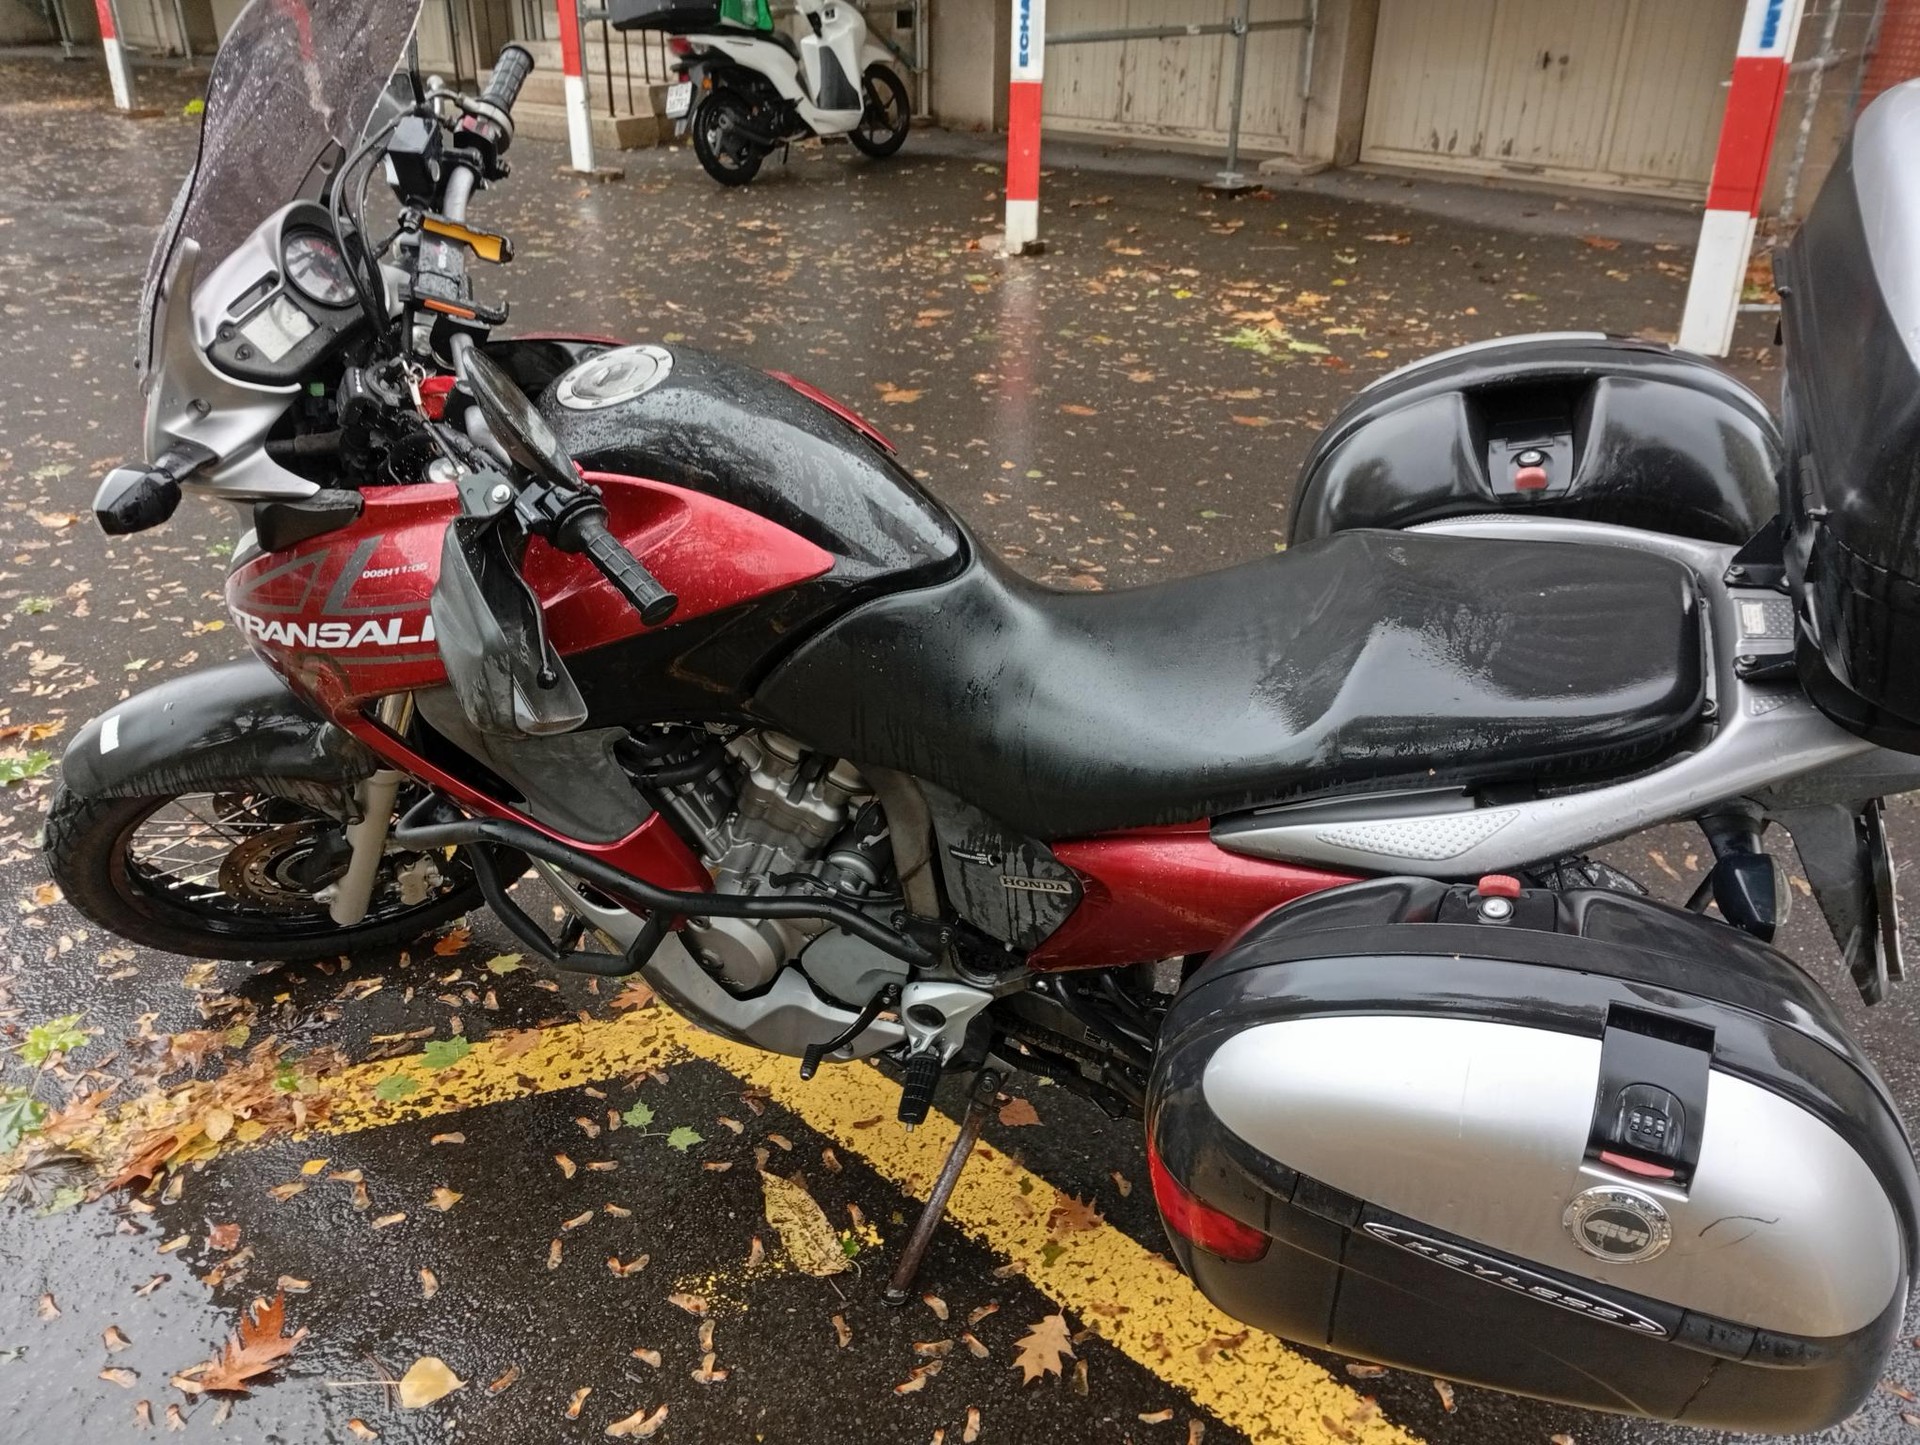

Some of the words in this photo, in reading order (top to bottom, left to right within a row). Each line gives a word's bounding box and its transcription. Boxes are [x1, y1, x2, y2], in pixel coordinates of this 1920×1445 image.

[1003, 878, 1069, 892] HONDA
[1585, 1219, 1649, 1247] GIVI
[1404, 1241, 1624, 1319] KEYLESS
